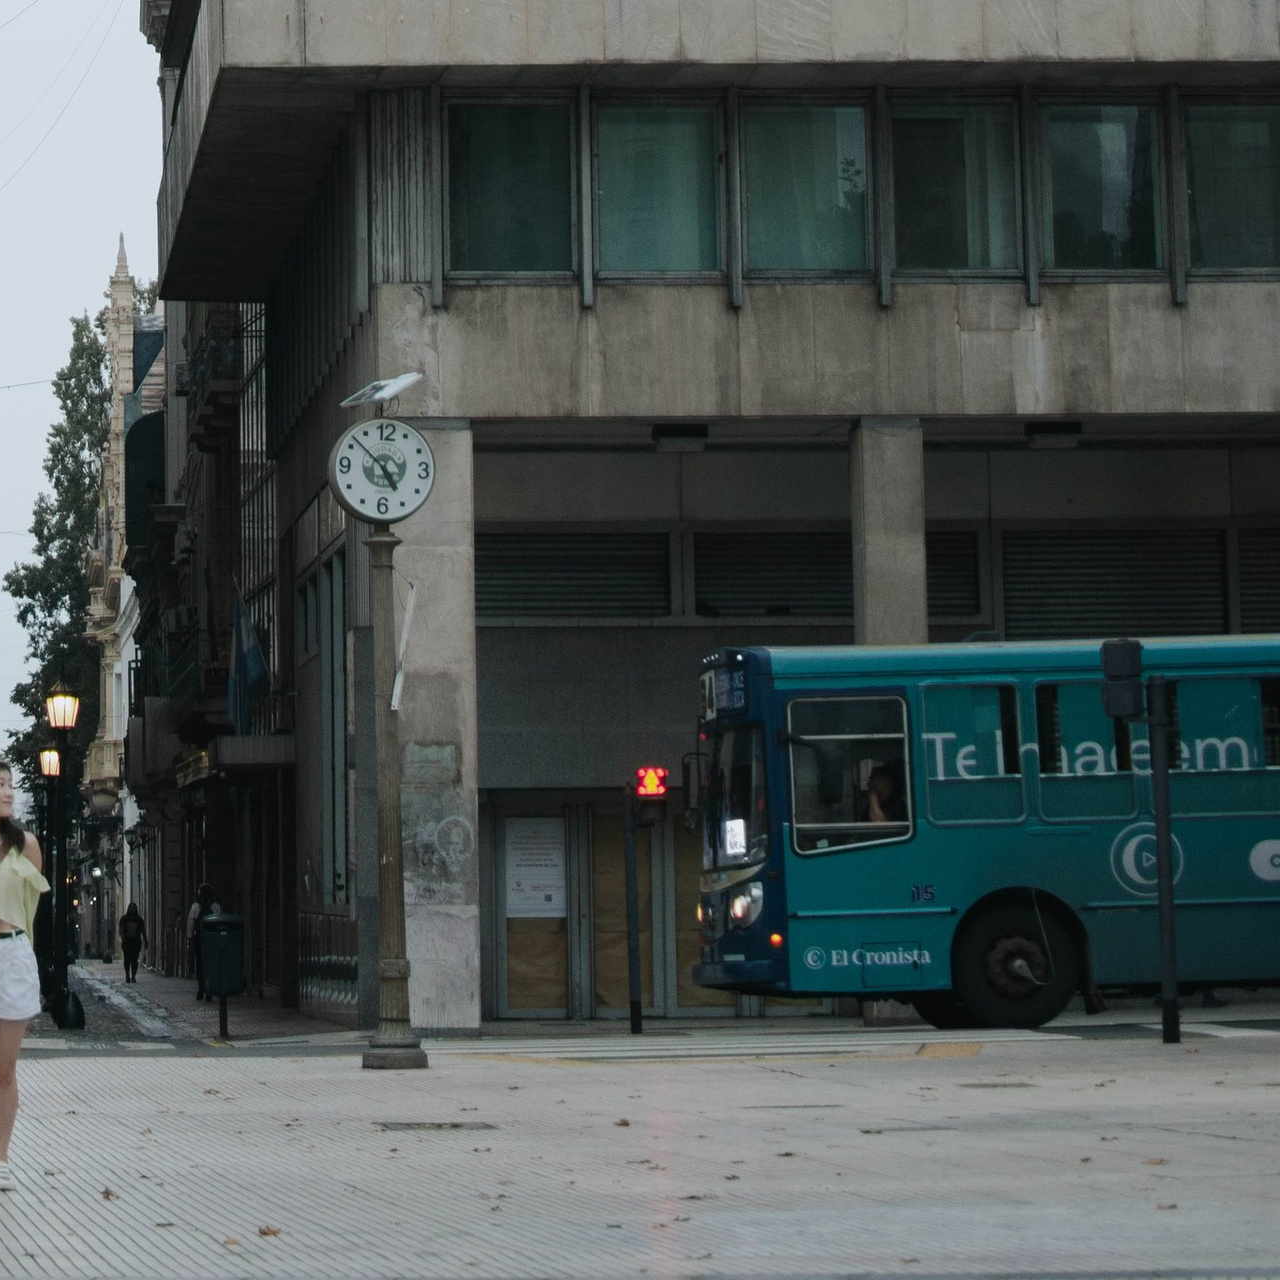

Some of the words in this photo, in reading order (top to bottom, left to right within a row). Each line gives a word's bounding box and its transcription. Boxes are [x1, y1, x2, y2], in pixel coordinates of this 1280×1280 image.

[376, 423, 396, 442] 12
[369, 445, 398, 458] IUDAD
[339, 456, 351, 474] 9
[418, 462, 429, 479] 3
[377, 497, 388, 514] 6
[911, 884, 936, 903] 15
[830, 949, 849, 966] El
[851, 946, 931, 966] Cronista
